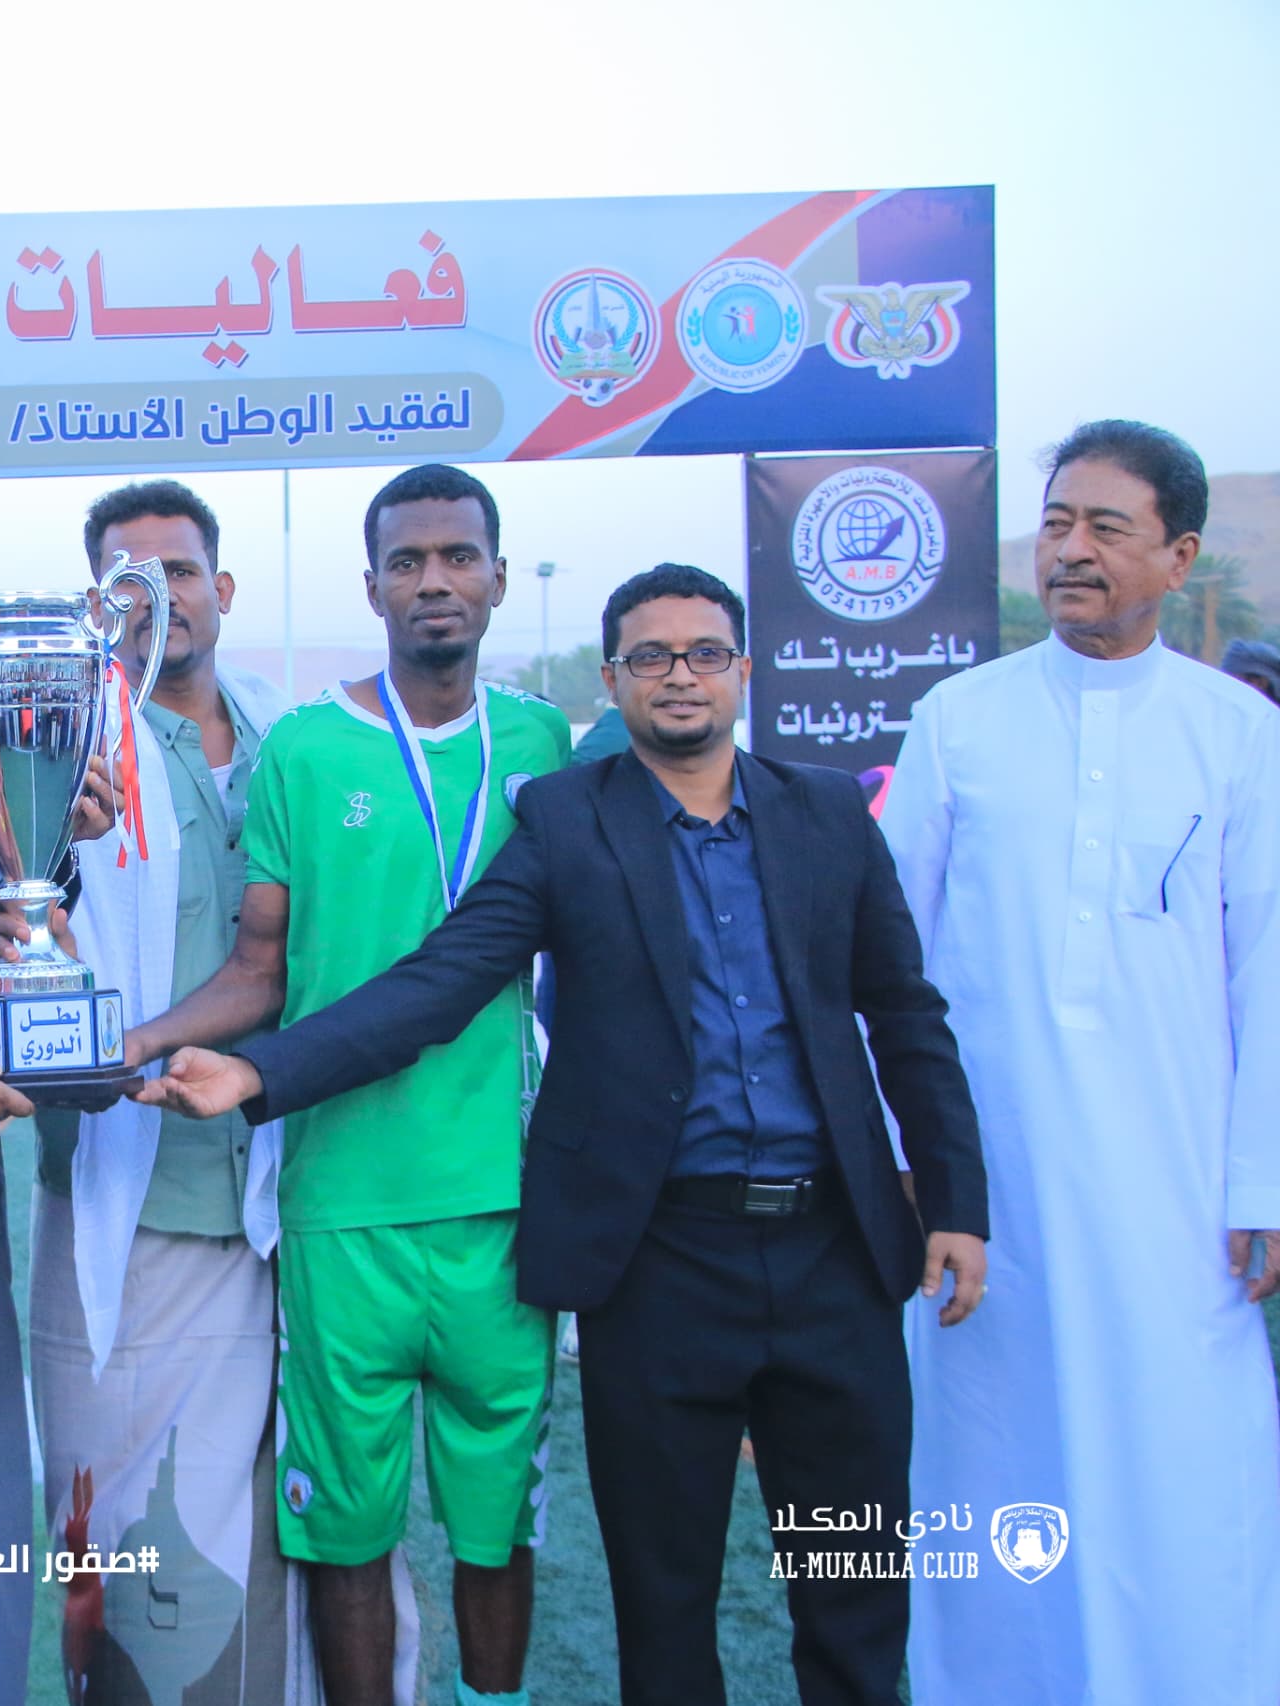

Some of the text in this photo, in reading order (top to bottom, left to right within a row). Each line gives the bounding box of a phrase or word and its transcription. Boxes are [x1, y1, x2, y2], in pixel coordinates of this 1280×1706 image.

[5, 228, 468, 369] فعاليات
[200, 392, 335, 446] الوطن
[346, 388, 472, 443] لفقيد
[844, 564, 898, 581] A.M.B
[820, 580, 920, 615] 05417932
[774, 632, 977, 680] باغريب تك
[776, 700, 914, 746] ترونيات
[20, 1004, 82, 1033] بطل
[21, 1034, 83, 1066] الدوري
